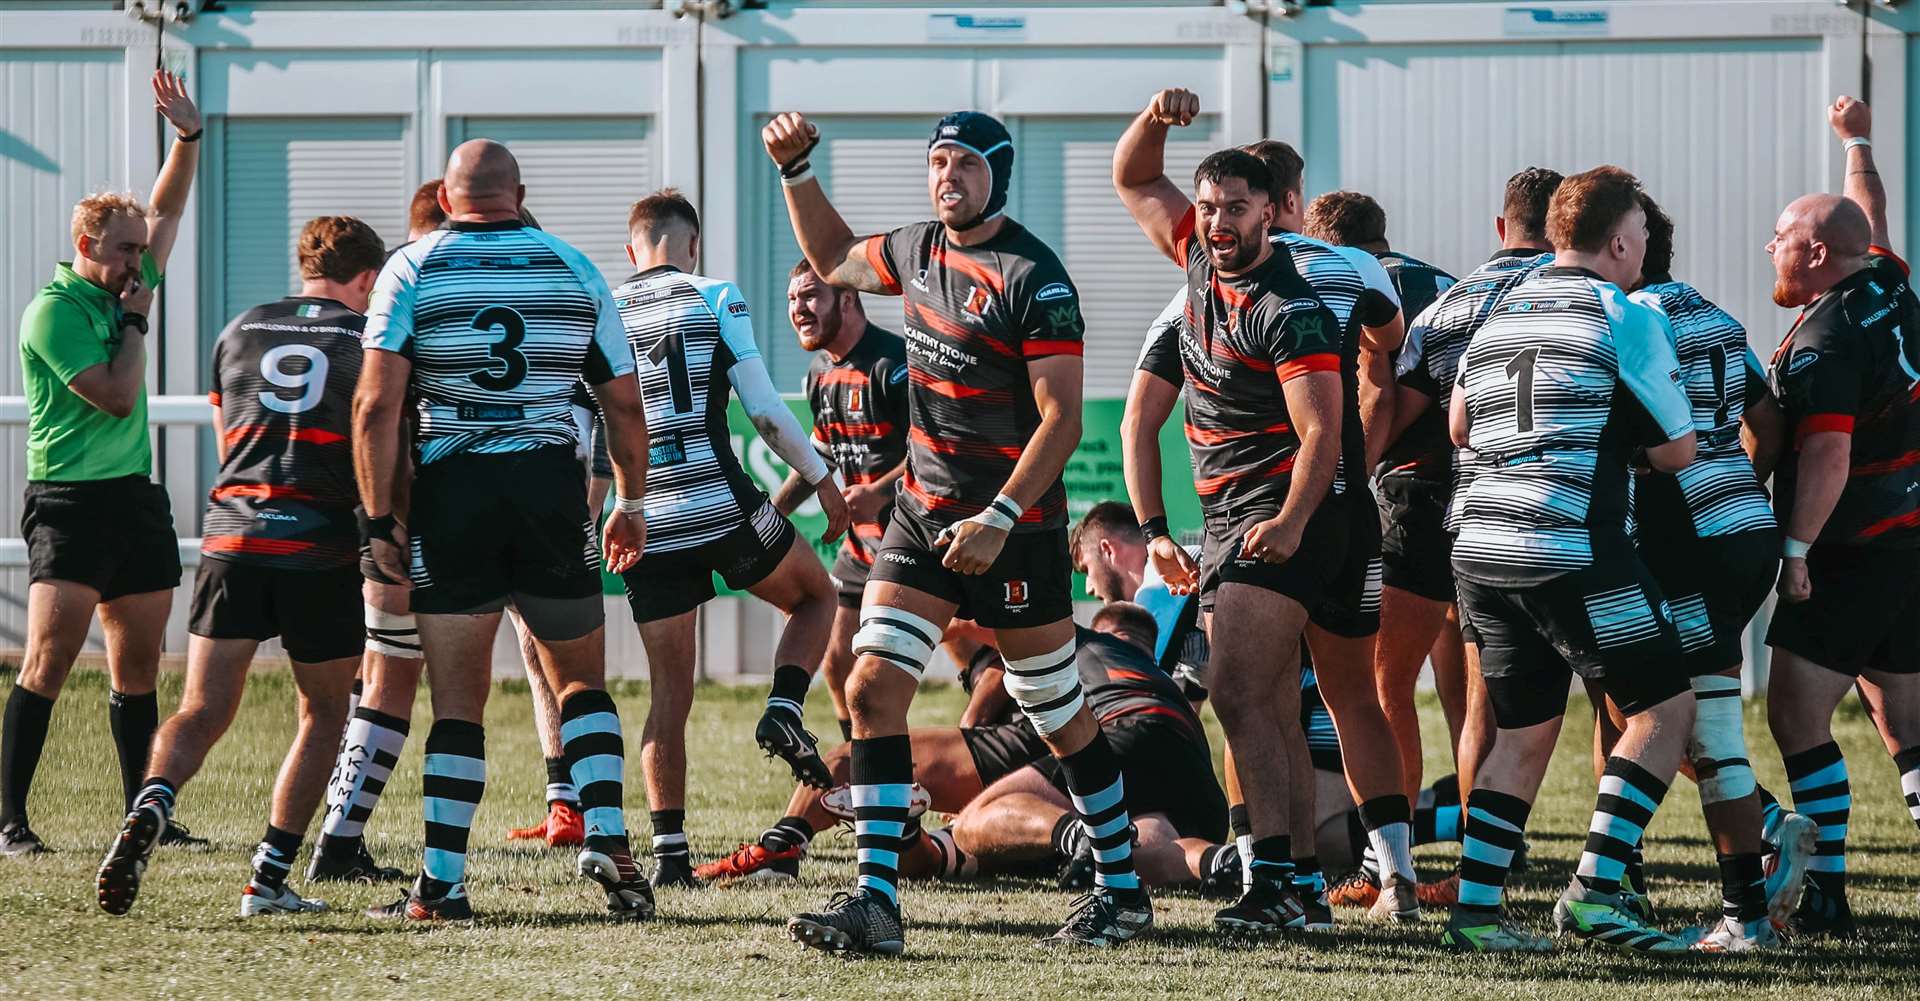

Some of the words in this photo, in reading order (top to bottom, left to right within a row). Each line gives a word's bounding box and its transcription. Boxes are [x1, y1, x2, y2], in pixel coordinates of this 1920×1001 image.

[257, 344, 329, 414] 9
[467, 305, 529, 393] 3
[939, 341, 978, 366] STONE
[1503, 345, 1541, 433] 1
[333, 744, 369, 817] AKUMA
